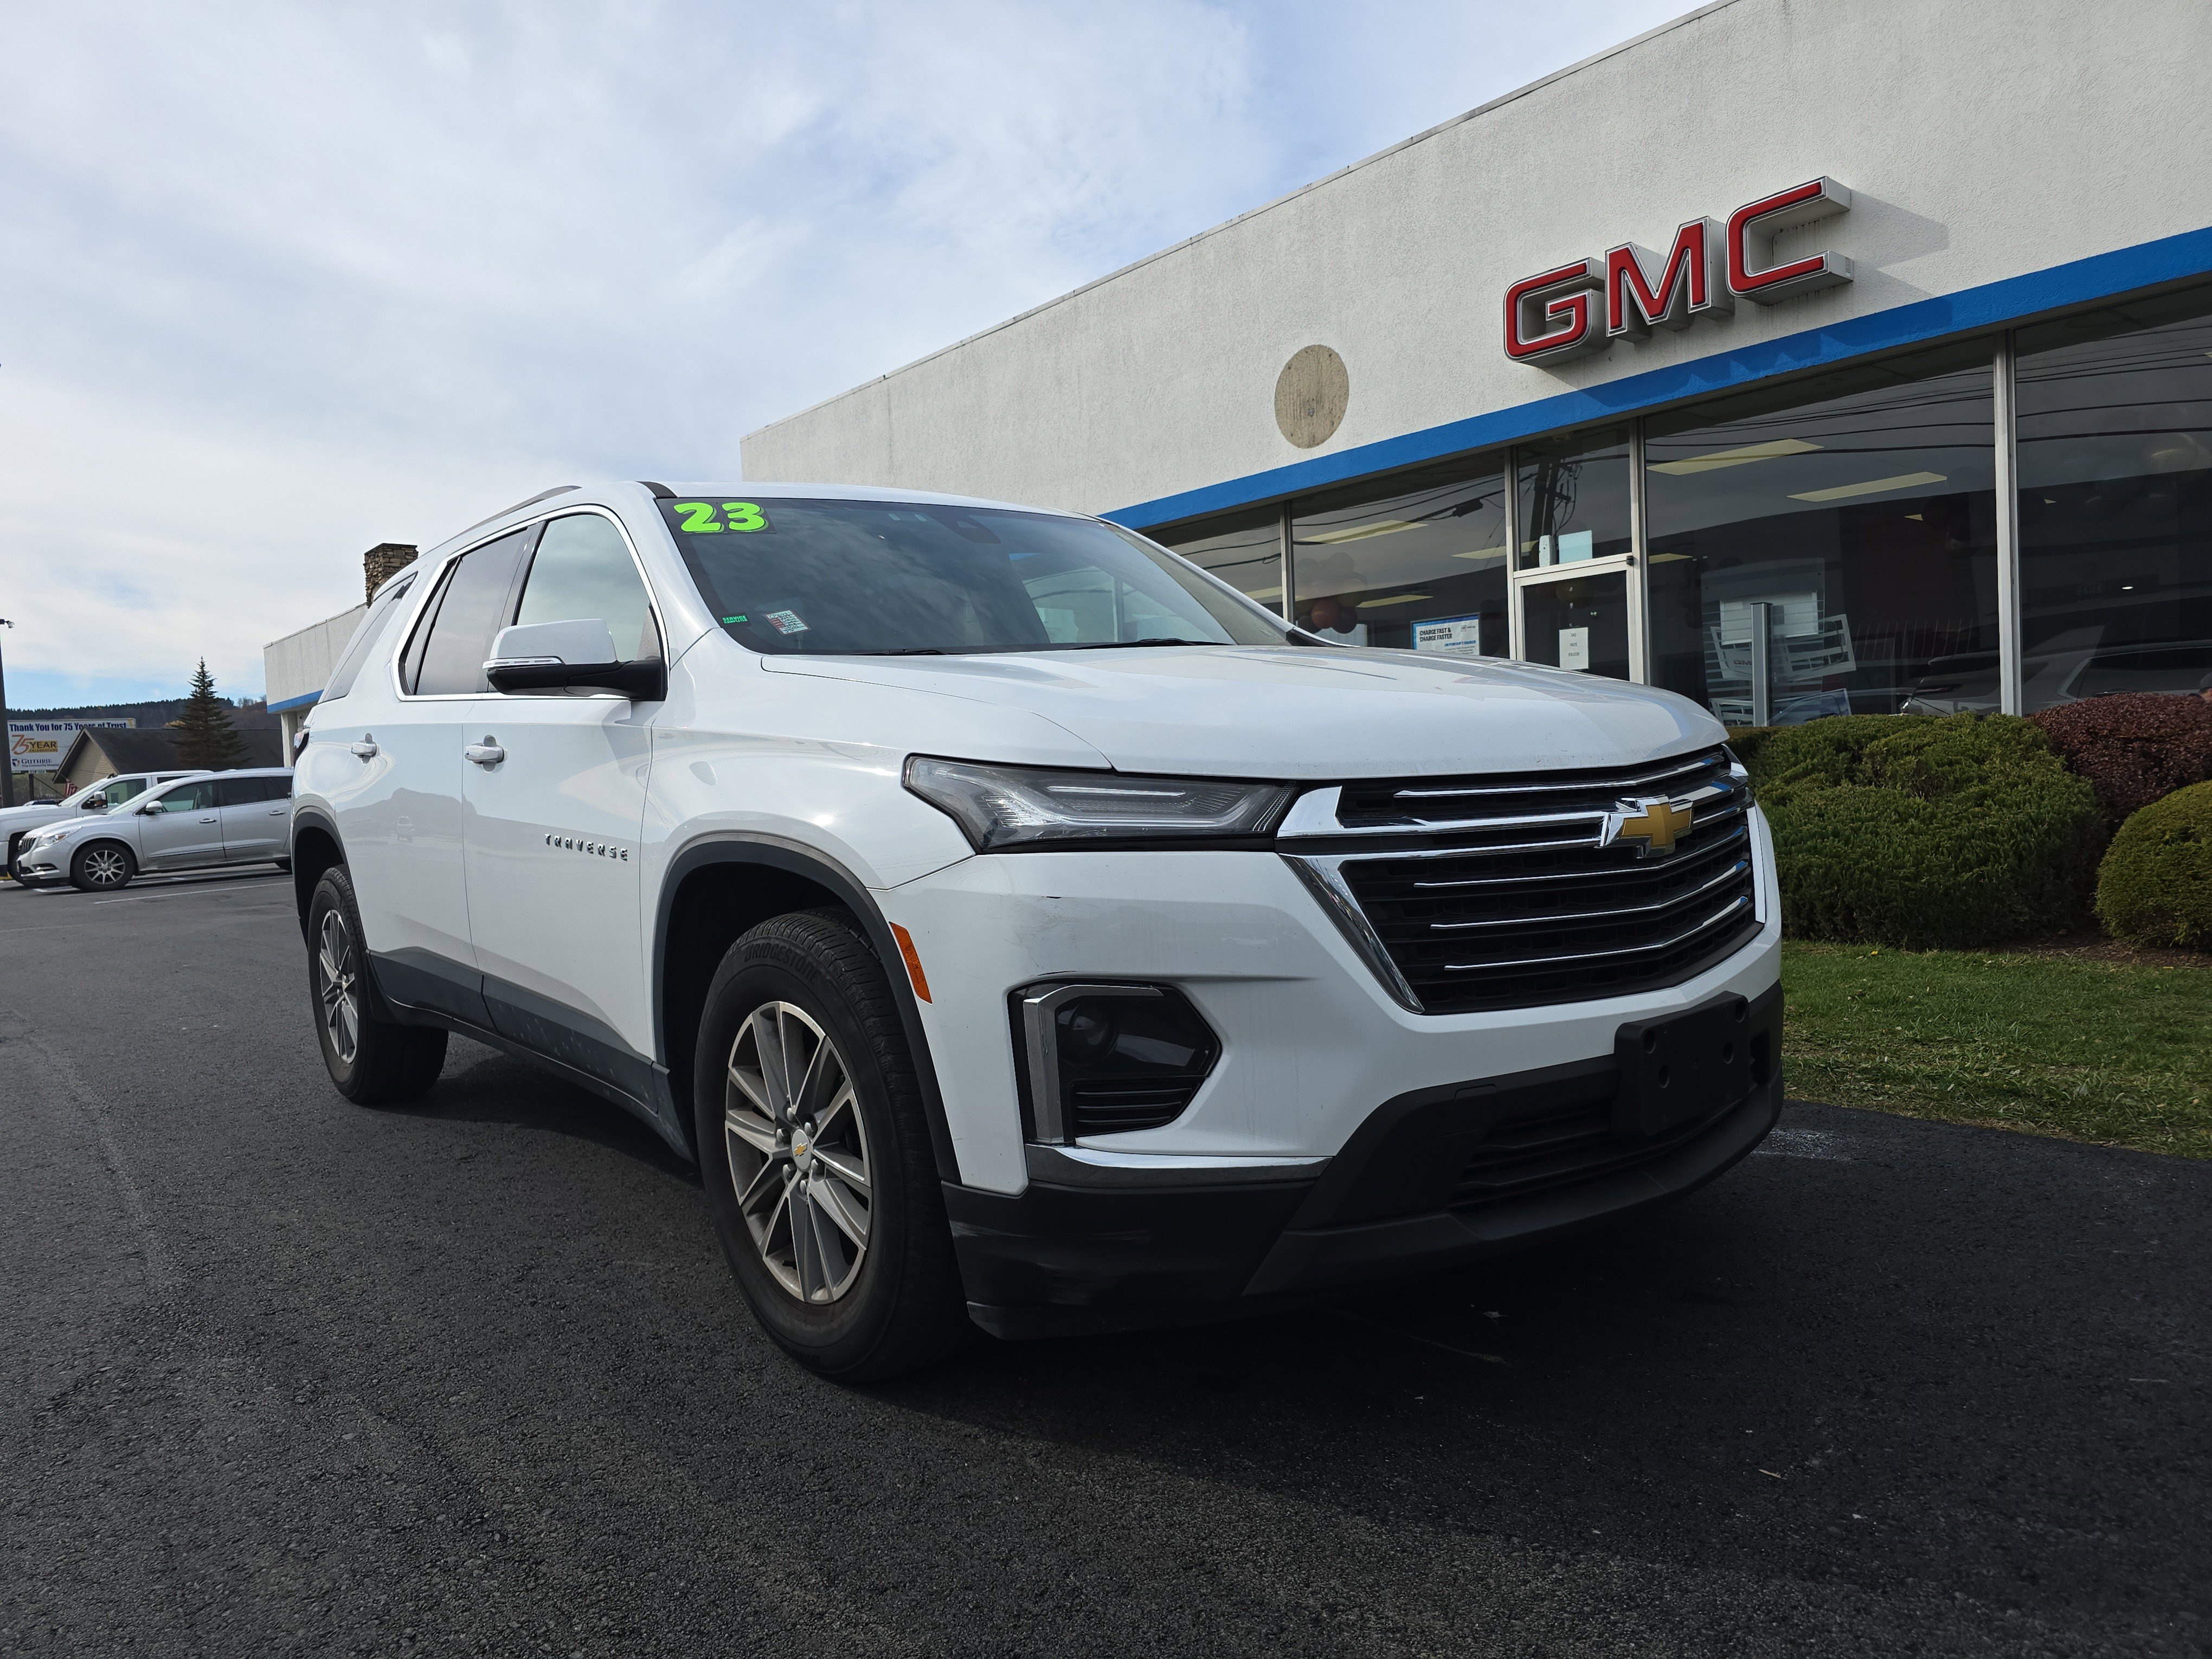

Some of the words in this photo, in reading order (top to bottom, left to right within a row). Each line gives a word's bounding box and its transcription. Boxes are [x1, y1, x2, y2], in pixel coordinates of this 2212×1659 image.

[1503, 176, 1846, 362] GMC
[674, 502, 769, 533] 23
[9, 723, 34, 732] Thank
[35, 723, 50, 731] You
[63, 723, 73, 731] 75
[11, 734, 35, 755] 75
[545, 833, 628, 861] TRAVERSE
[744, 942, 822, 986] BRIDGESTONE
